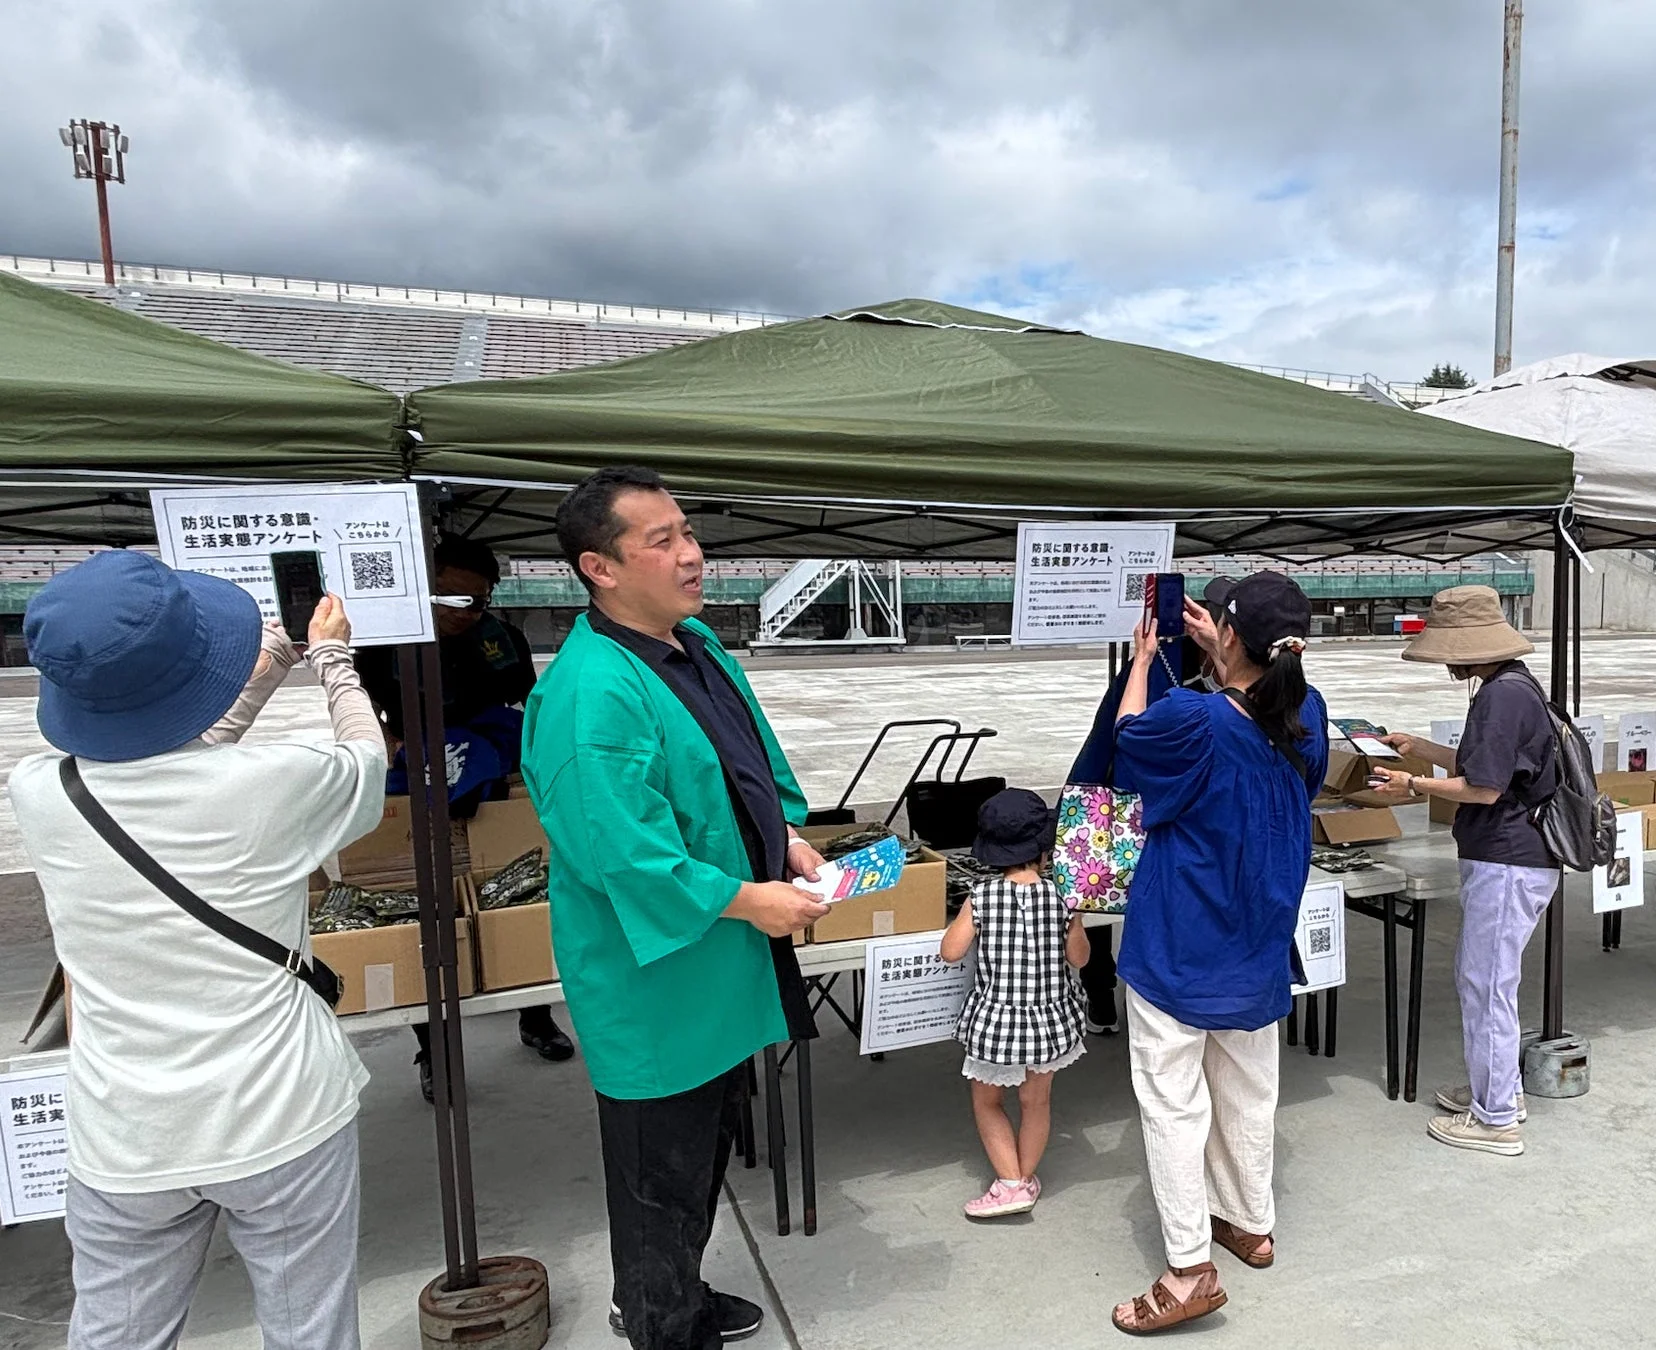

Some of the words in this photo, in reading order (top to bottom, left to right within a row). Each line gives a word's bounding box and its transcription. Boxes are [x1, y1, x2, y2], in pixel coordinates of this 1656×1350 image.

[181, 512, 319, 530] 防災に関する意識・
[344, 521, 390, 529] アンケートは
[184, 530, 323, 548] 生活実態アンケート
[348, 531, 389, 539] こちらから
[1032, 542, 1114, 553] 防災に関する意識・
[1031, 555, 1113, 567] 生活実態アンケート
[882, 954, 945, 970] 防災に関する
[881, 963, 966, 982] 生活実態アンケート
[11, 1093, 63, 1110] 防災に
[14, 1109, 65, 1127] 生活実
